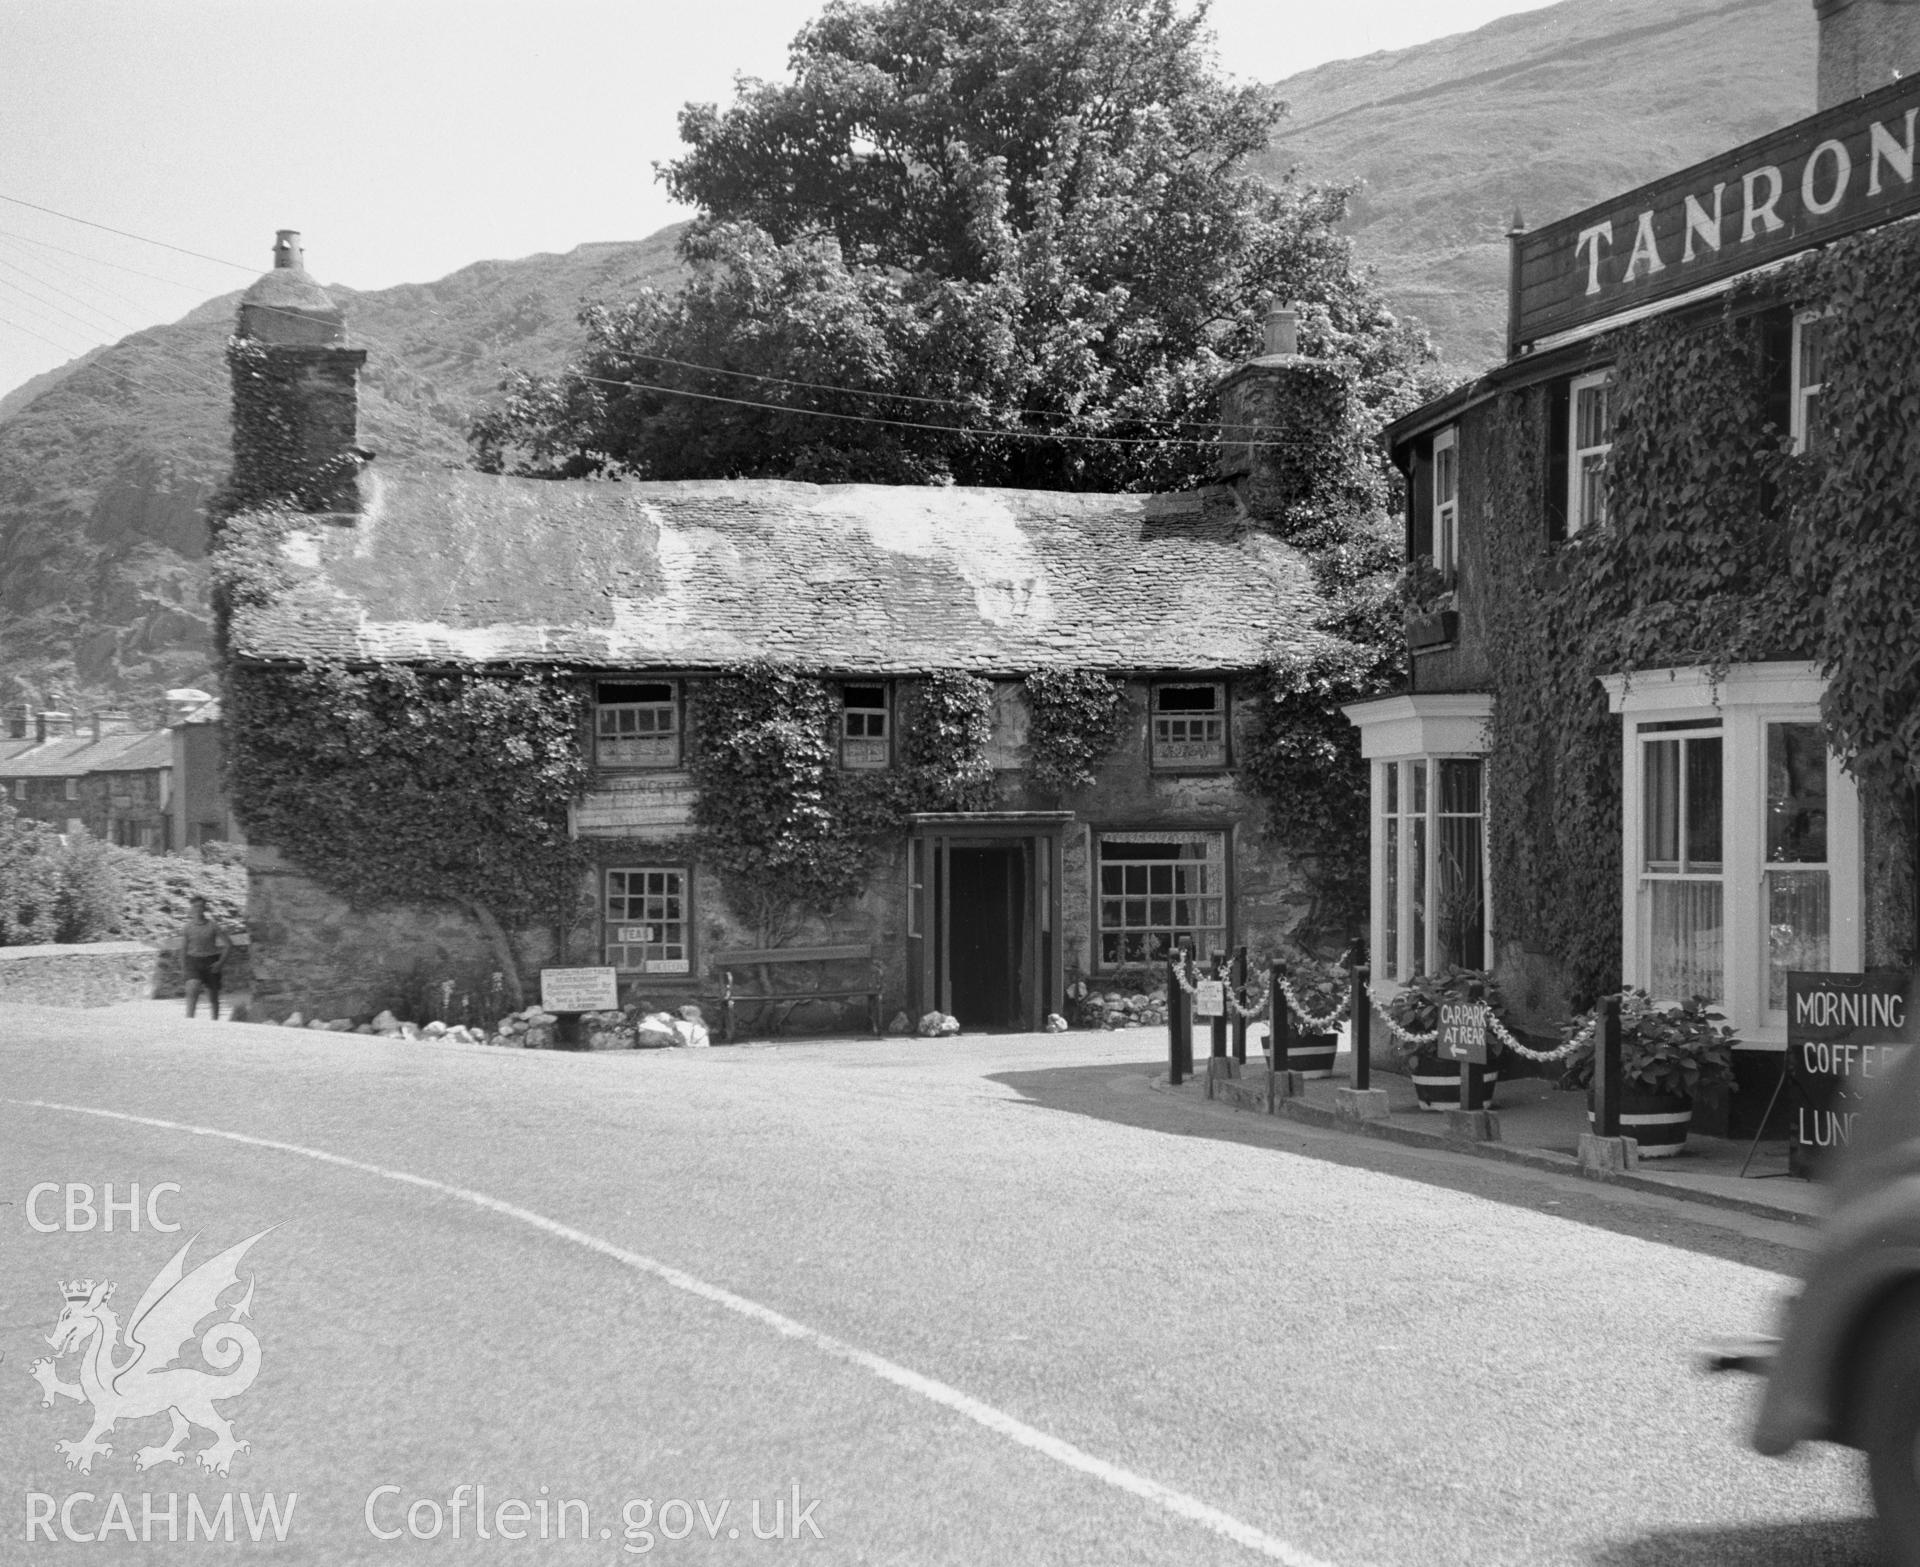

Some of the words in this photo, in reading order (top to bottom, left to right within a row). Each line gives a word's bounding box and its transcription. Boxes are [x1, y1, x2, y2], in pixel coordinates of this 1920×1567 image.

[1575, 107, 1920, 296] TANRON
[1796, 992, 1906, 1028] MORNING
[1444, 1026, 1459, 1043] AT
[1460, 1026, 1485, 1046] REAR
